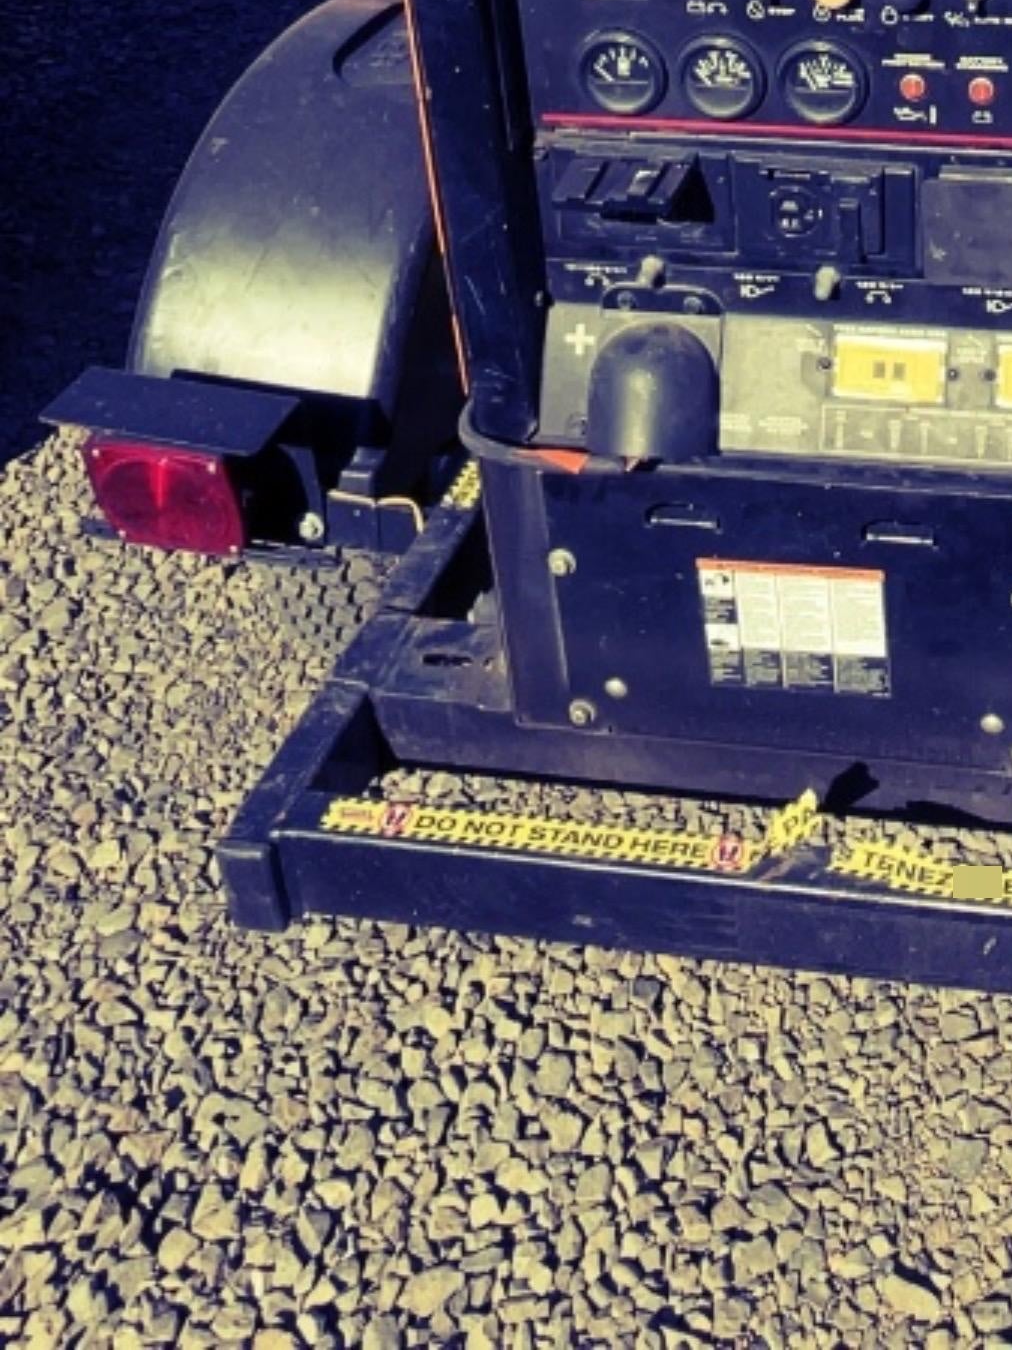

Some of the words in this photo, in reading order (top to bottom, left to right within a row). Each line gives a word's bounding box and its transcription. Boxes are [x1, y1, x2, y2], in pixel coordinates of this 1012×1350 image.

[414, 814, 458, 832] DO
[463, 819, 525, 838] NOT
[526, 825, 626, 851] STAND
[628, 836, 708, 860] HERE
